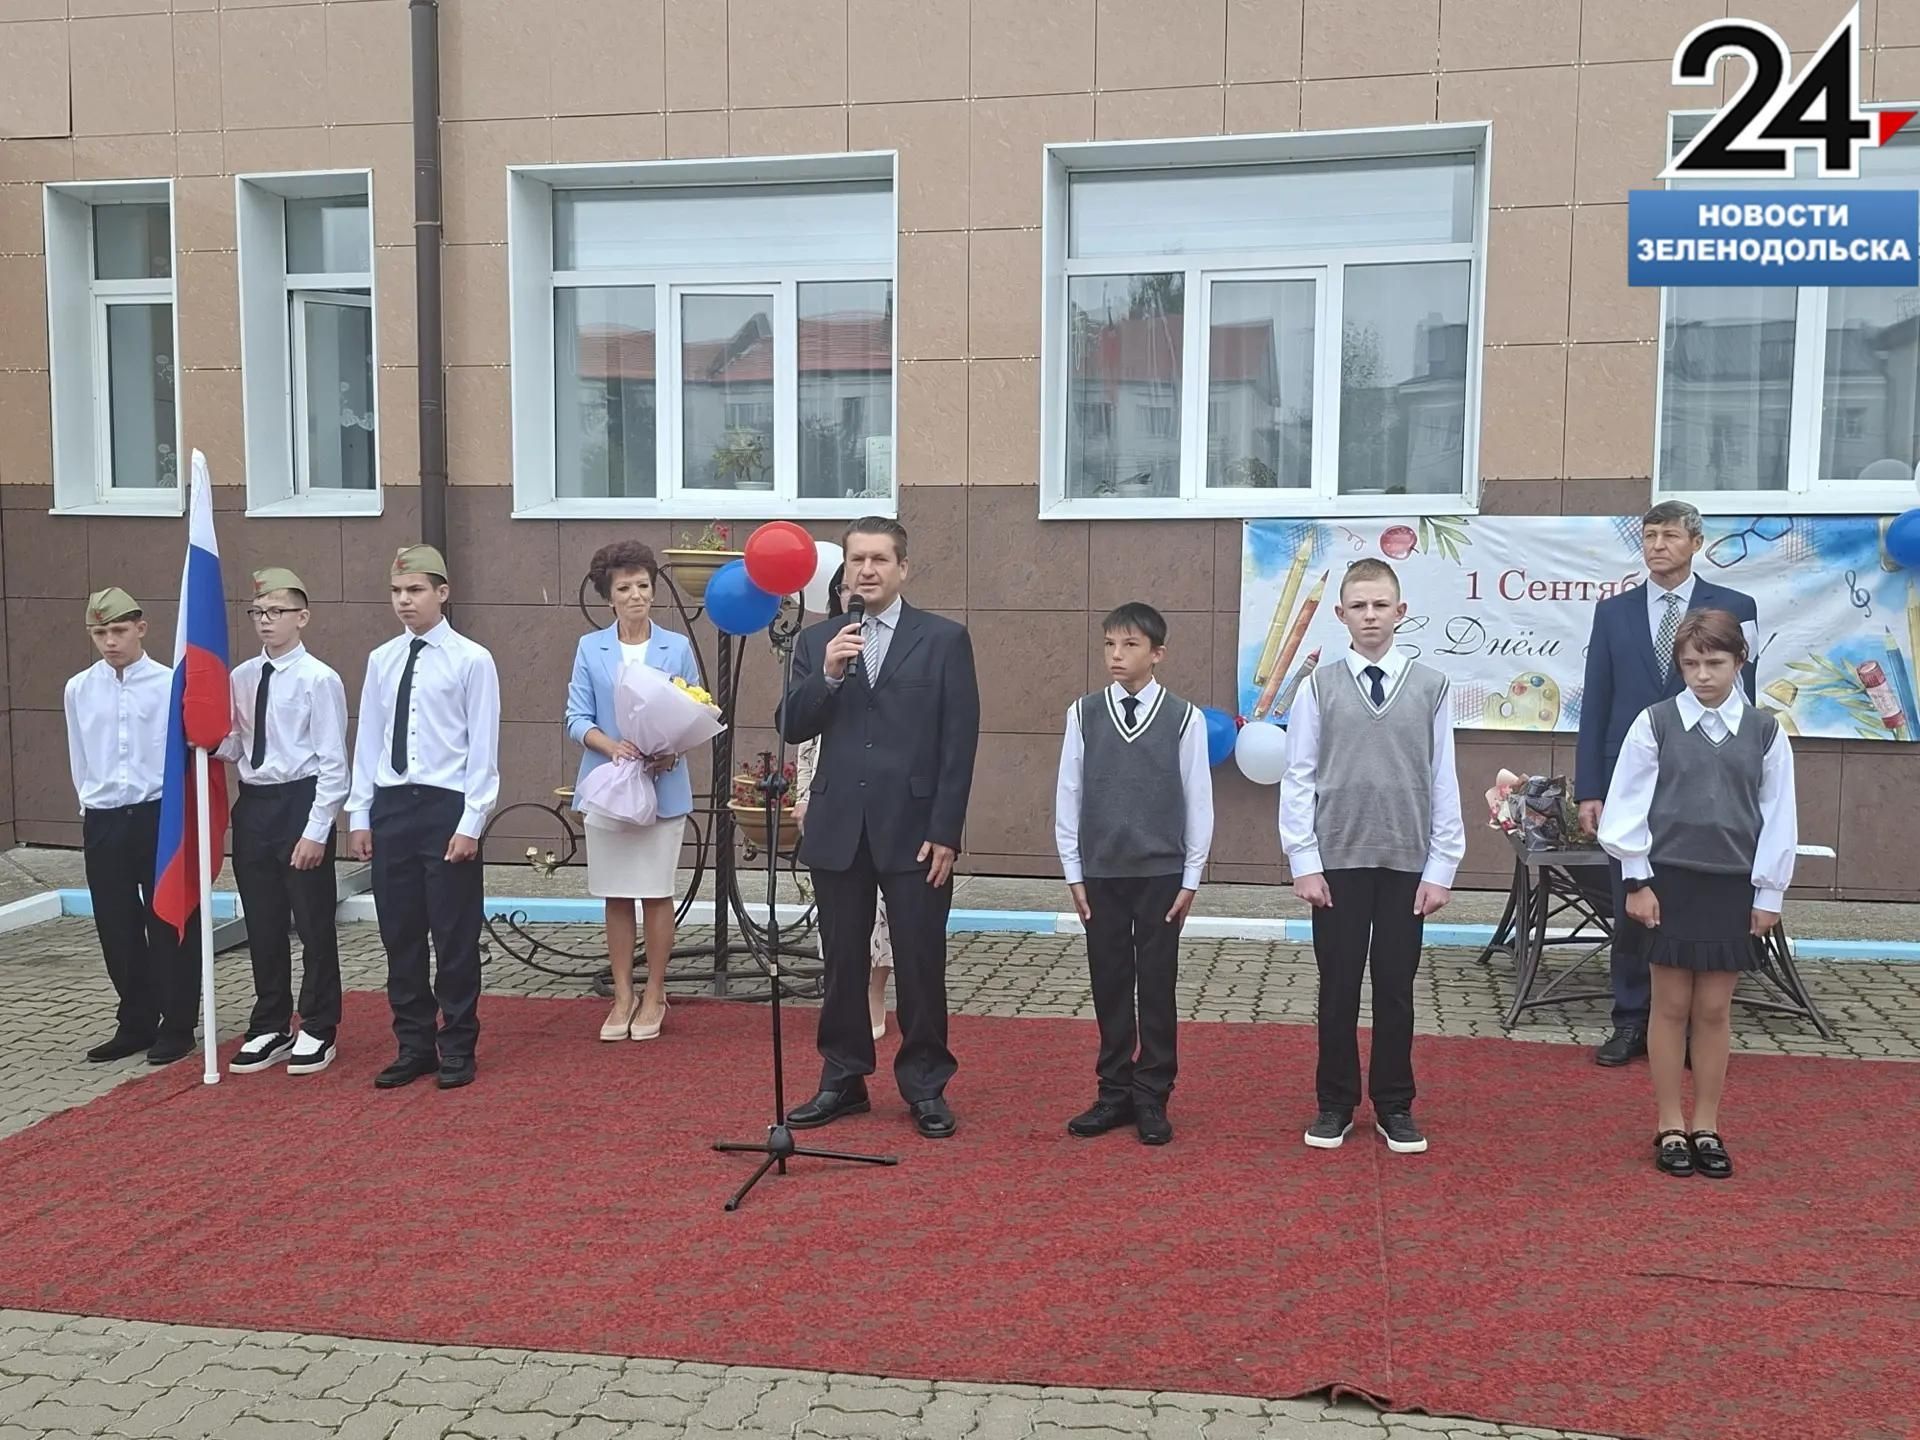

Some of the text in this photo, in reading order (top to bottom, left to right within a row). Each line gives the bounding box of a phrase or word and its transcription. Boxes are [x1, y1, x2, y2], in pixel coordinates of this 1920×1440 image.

[1465, 568, 1641, 602] 1 Сентяб
[1433, 615, 1563, 657] Днём
